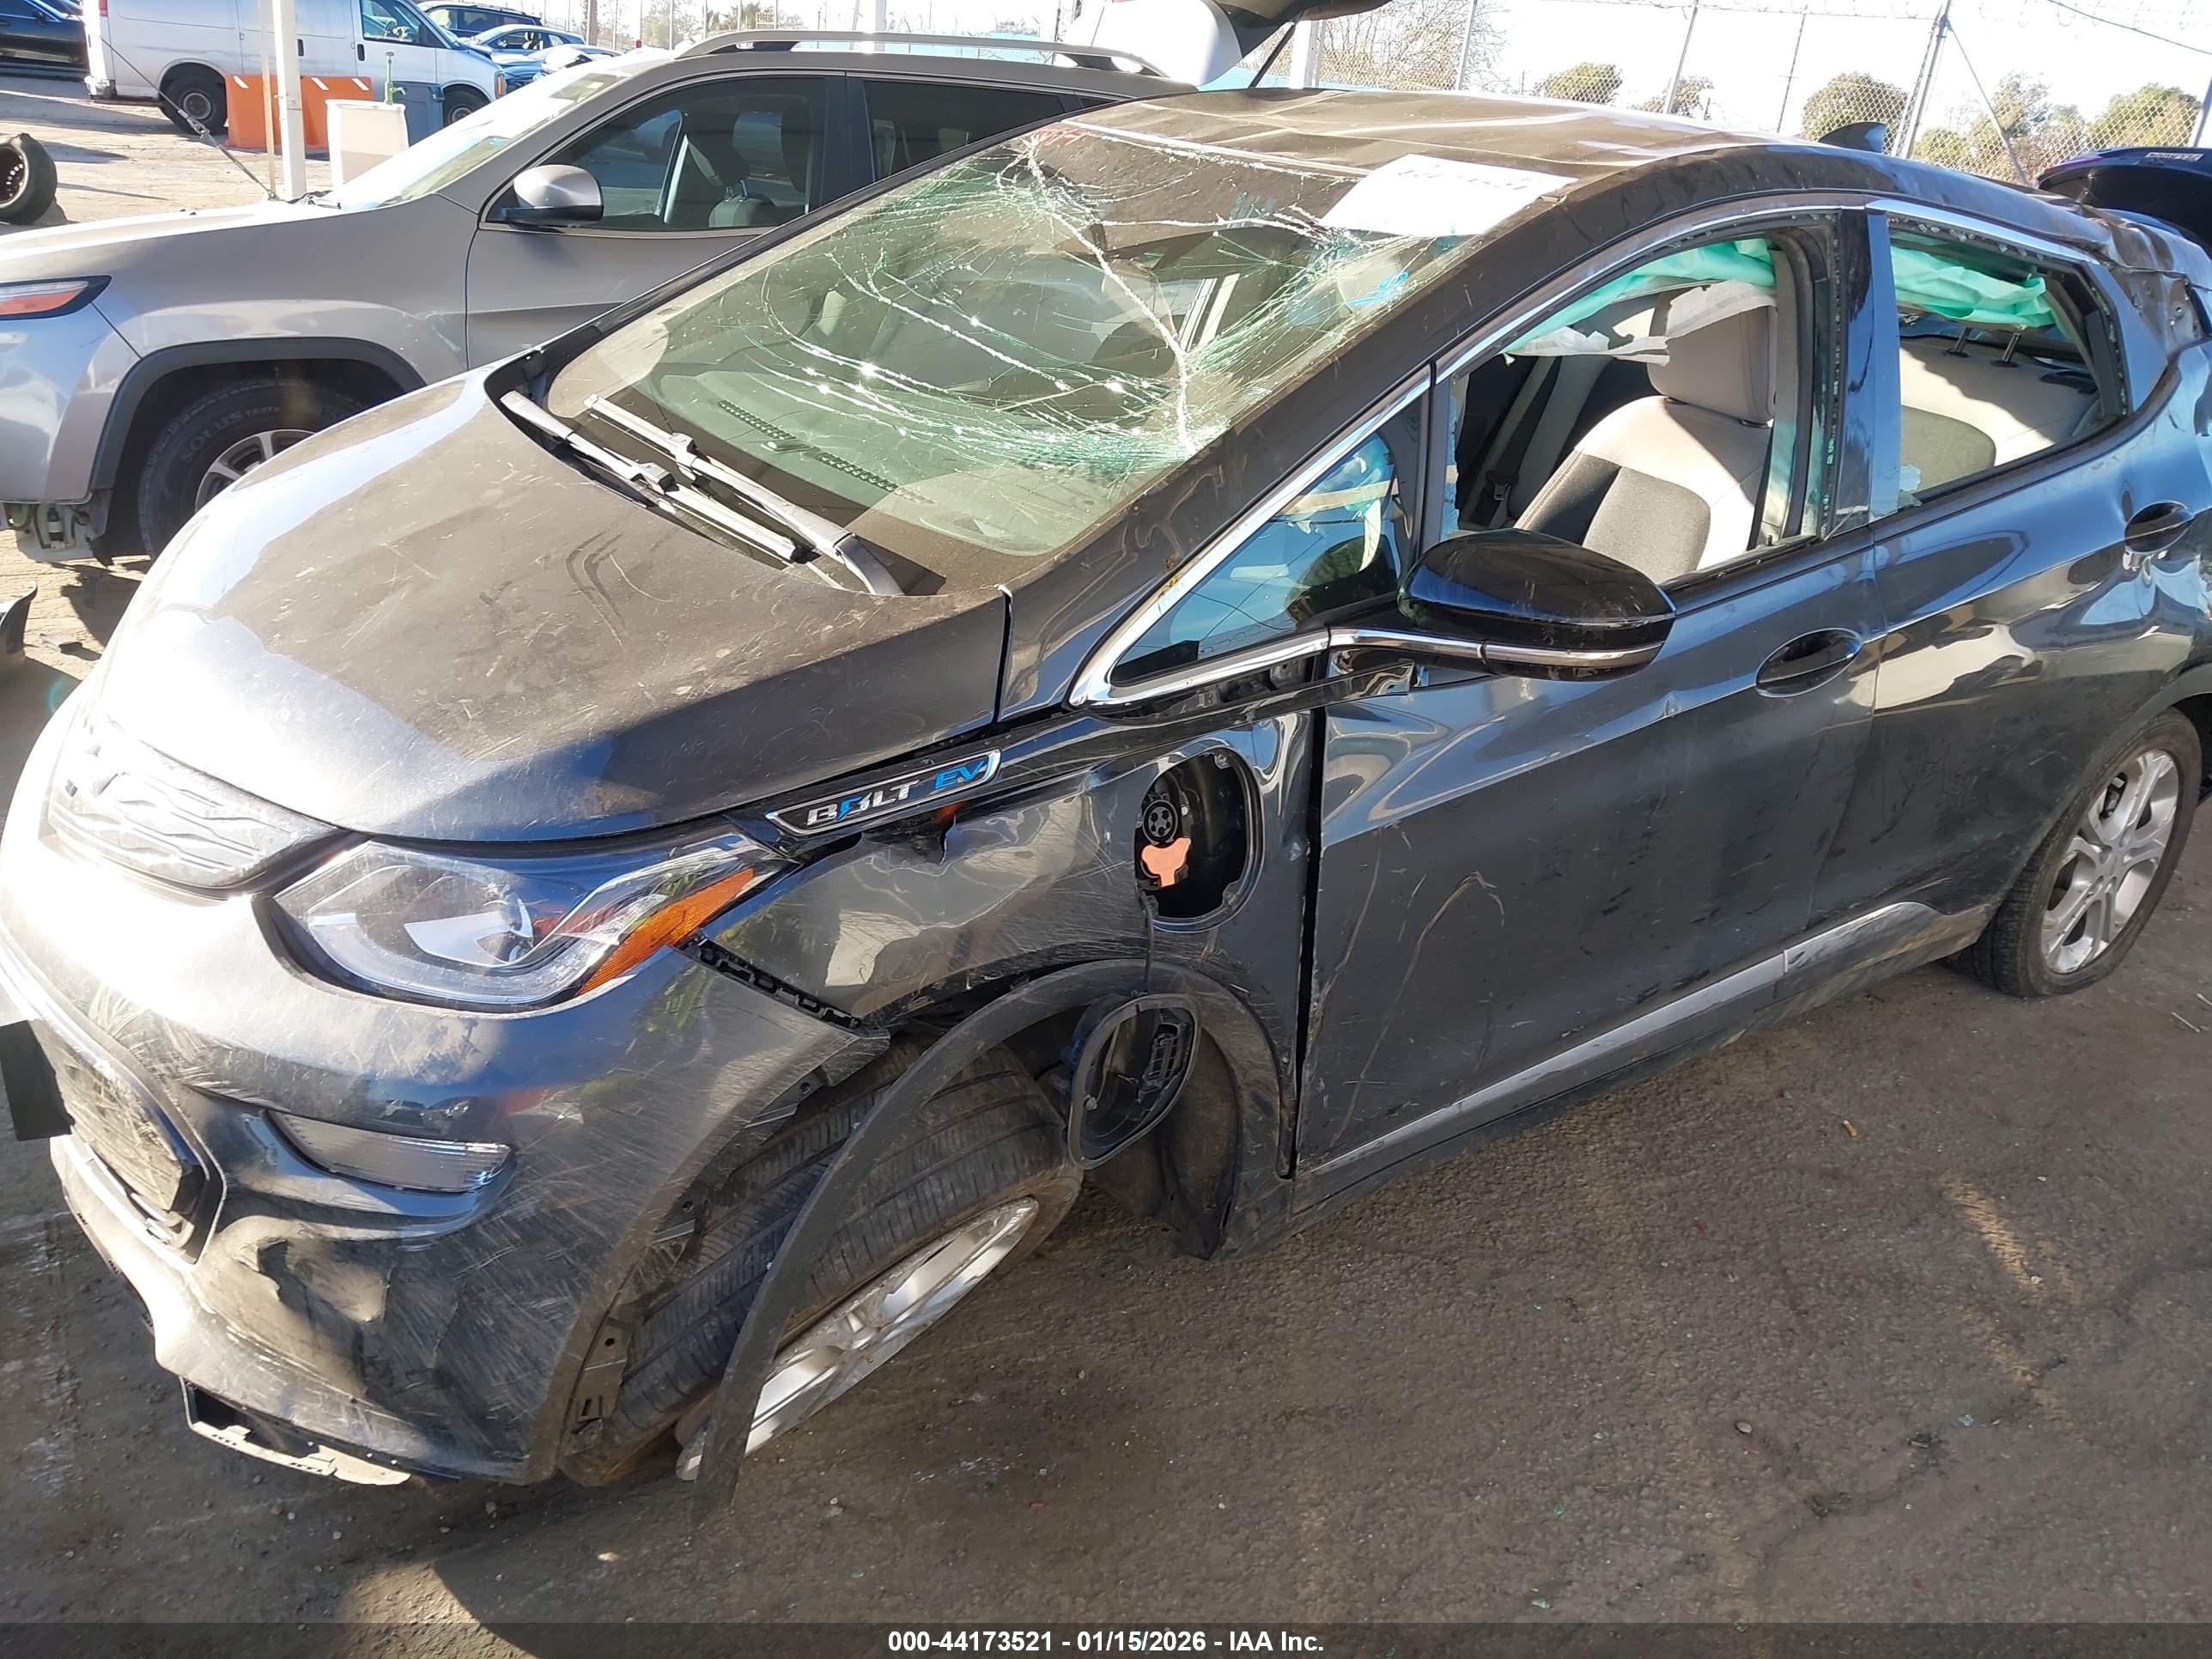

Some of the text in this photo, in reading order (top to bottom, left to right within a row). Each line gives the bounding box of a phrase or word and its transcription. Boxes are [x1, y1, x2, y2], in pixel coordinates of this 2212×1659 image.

[179, 410, 244, 465] SOLUS
[806, 760, 986, 826] BOLT EV
